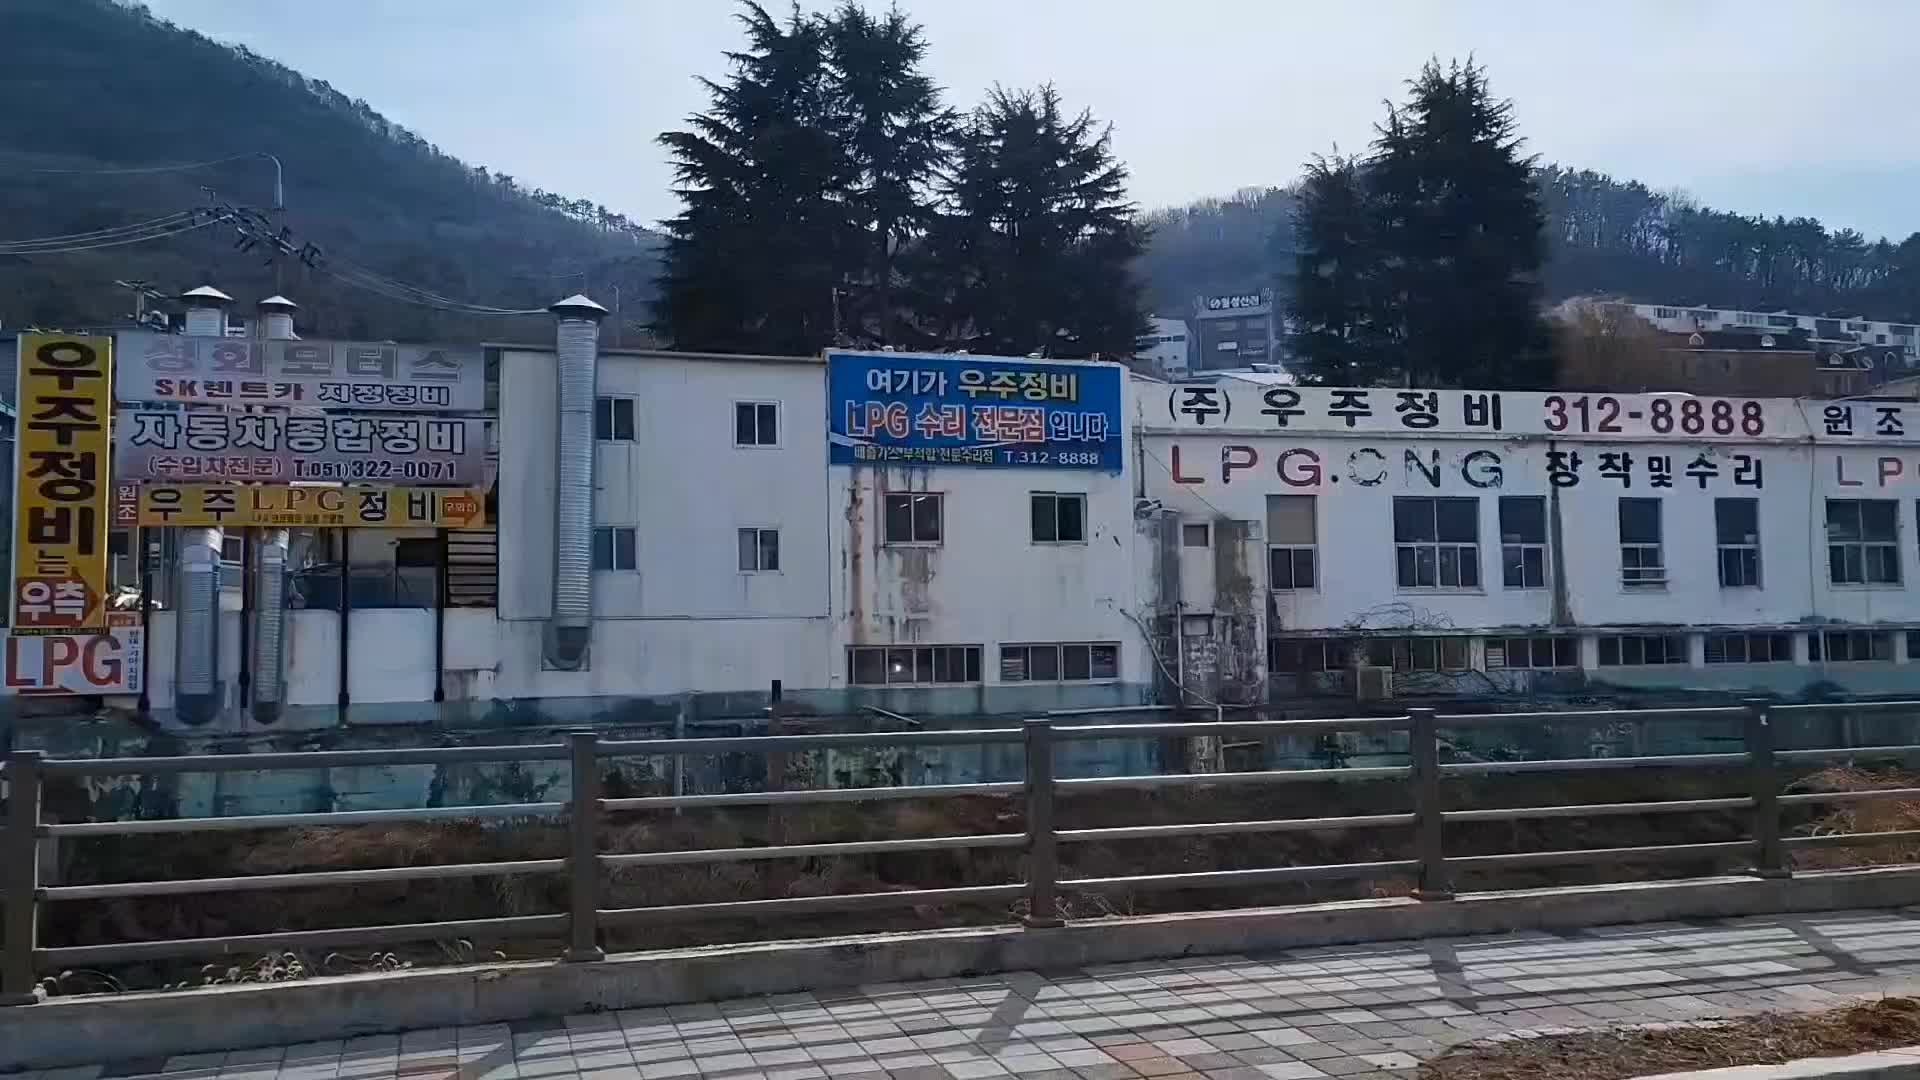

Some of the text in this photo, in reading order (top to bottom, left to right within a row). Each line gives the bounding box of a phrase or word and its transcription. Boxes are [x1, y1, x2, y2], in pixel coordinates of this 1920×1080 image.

[153, 378, 450, 405] SK렌트카 지정정비
[866, 368, 1077, 401] 여기가 우주정비
[131, 413, 466, 454] 자동차종합정비
[845, 400, 1108, 443] LPG 수리 전문점 입니다
[1544, 396, 1764, 437] 312-8888
[148, 455, 282, 477] (수입차전문)
[1836, 455, 1920, 488] LP
[119, 486, 137, 520] 원조
[252, 490, 345, 511] LPG
[19, 581, 86, 622] 우측
[6, 636, 123, 688] LPG
